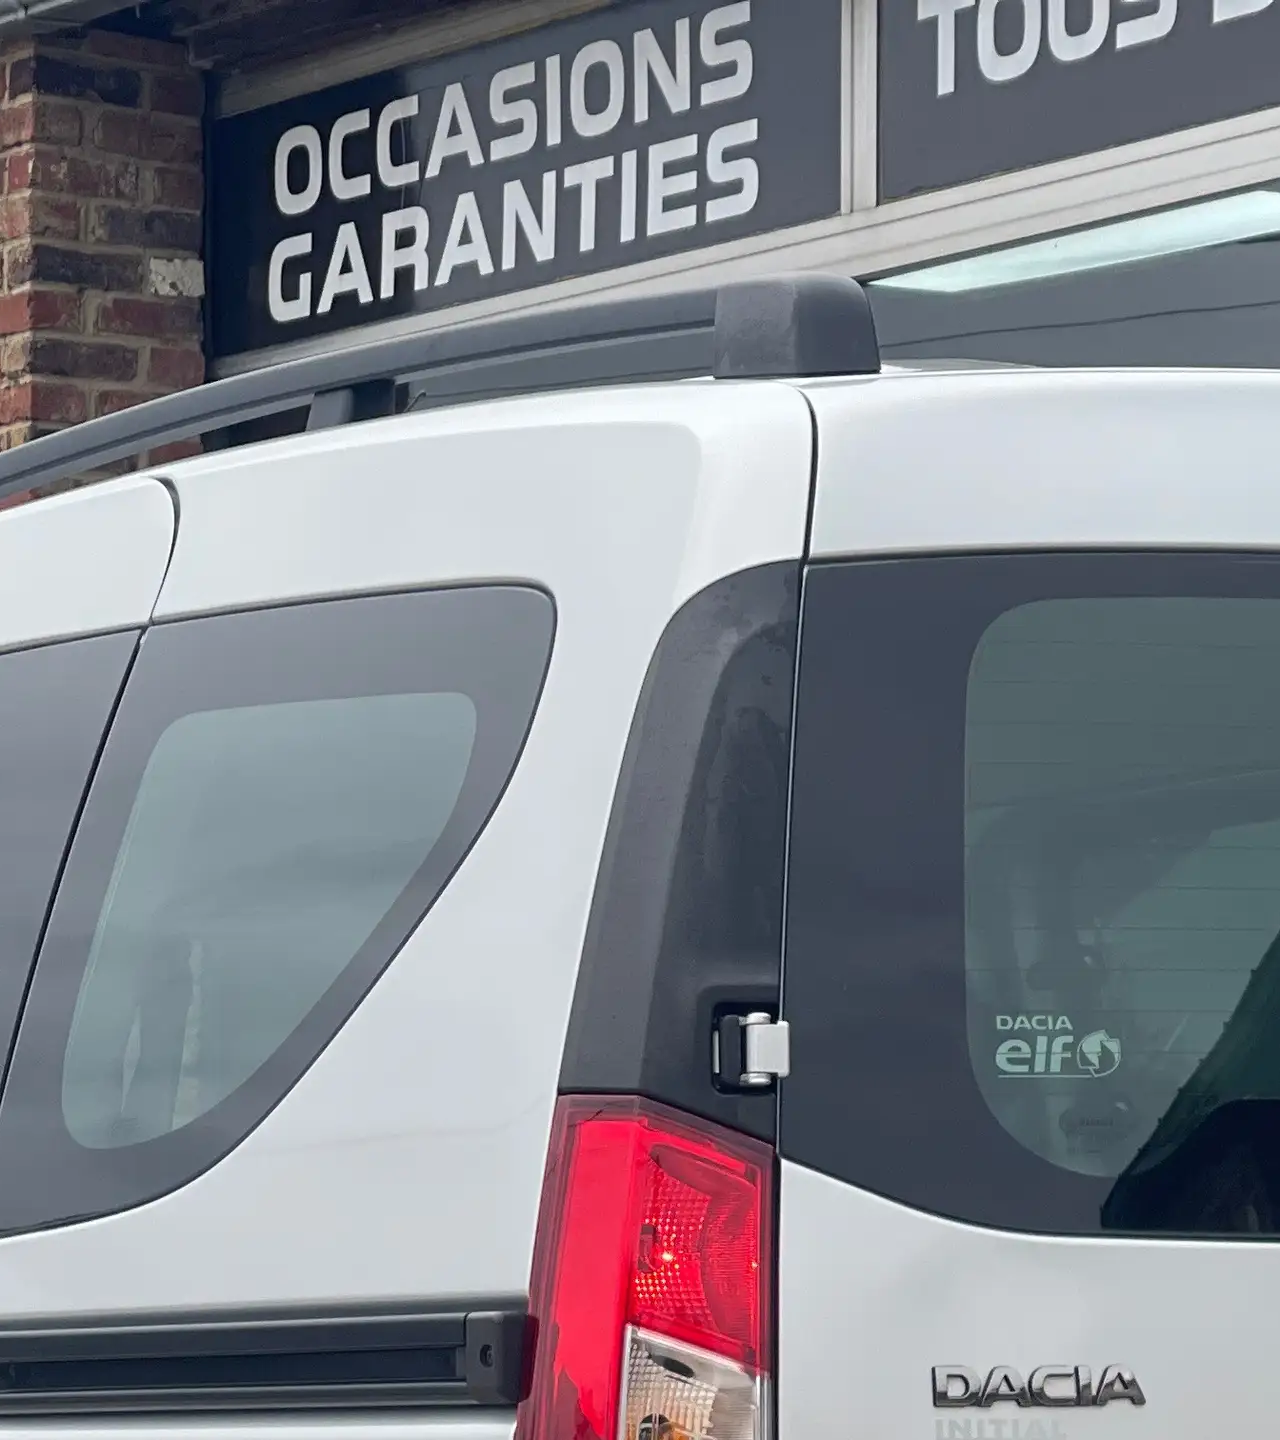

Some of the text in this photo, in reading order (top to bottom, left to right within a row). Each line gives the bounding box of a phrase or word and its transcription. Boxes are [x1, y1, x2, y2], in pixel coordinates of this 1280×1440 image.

[274, 0, 753, 216] OCCASIONS
[268, 118, 759, 323] GARANTIES
[995, 1015, 1073, 1030] DACIA
[995, 1036, 1074, 1073] elf
[931, 1363, 1147, 1408] DACIA
